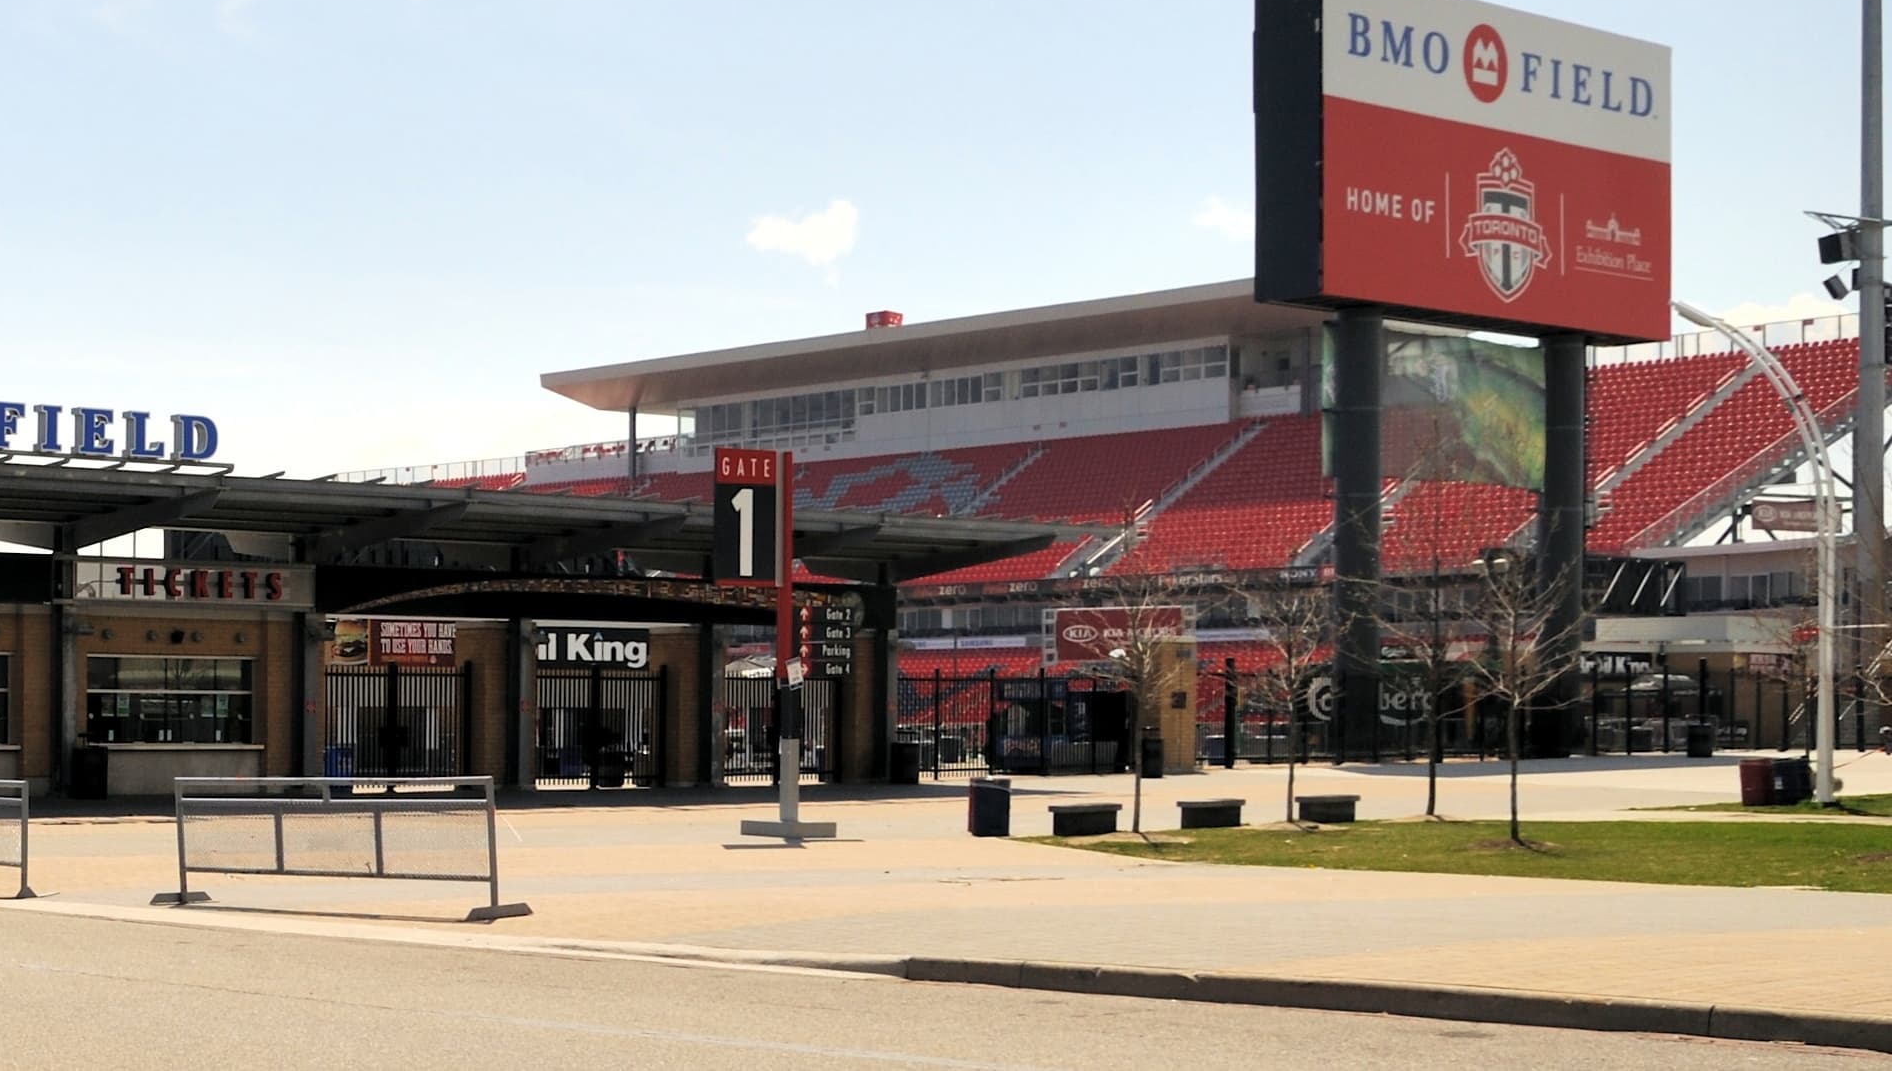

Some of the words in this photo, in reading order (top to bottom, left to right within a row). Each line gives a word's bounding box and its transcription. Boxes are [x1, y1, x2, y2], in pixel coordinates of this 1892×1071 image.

[1347, 12, 1450, 74] BMO
[1520, 51, 1653, 118] FIELD
[1346, 186, 1403, 219] HOME
[1411, 198, 1436, 224] OF
[1473, 220, 1538, 245] TORONTO
[1576, 244, 1625, 270] Exhibition
[1626, 253, 1652, 274] Place
[721, 456, 771, 478] GATE
[731, 488, 754, 578] 1
[116, 566, 283, 601] TICKETS
[826, 608, 843, 621] Gate
[845, 608, 851, 621] 2
[380, 621, 422, 638] SOMETIMES
[422, 622, 437, 638] YOU
[826, 626, 843, 639] Gate
[845, 626, 851, 639] 3
[1068, 628, 1093, 639] KIA
[380, 638, 391, 654] TO
[392, 638, 407, 654] USE
[408, 638, 427, 654] YOUR
[567, 631, 648, 669] King
[822, 643, 851, 659] Parking
[825, 662, 843, 675] Gate
[845, 662, 851, 674] 4
